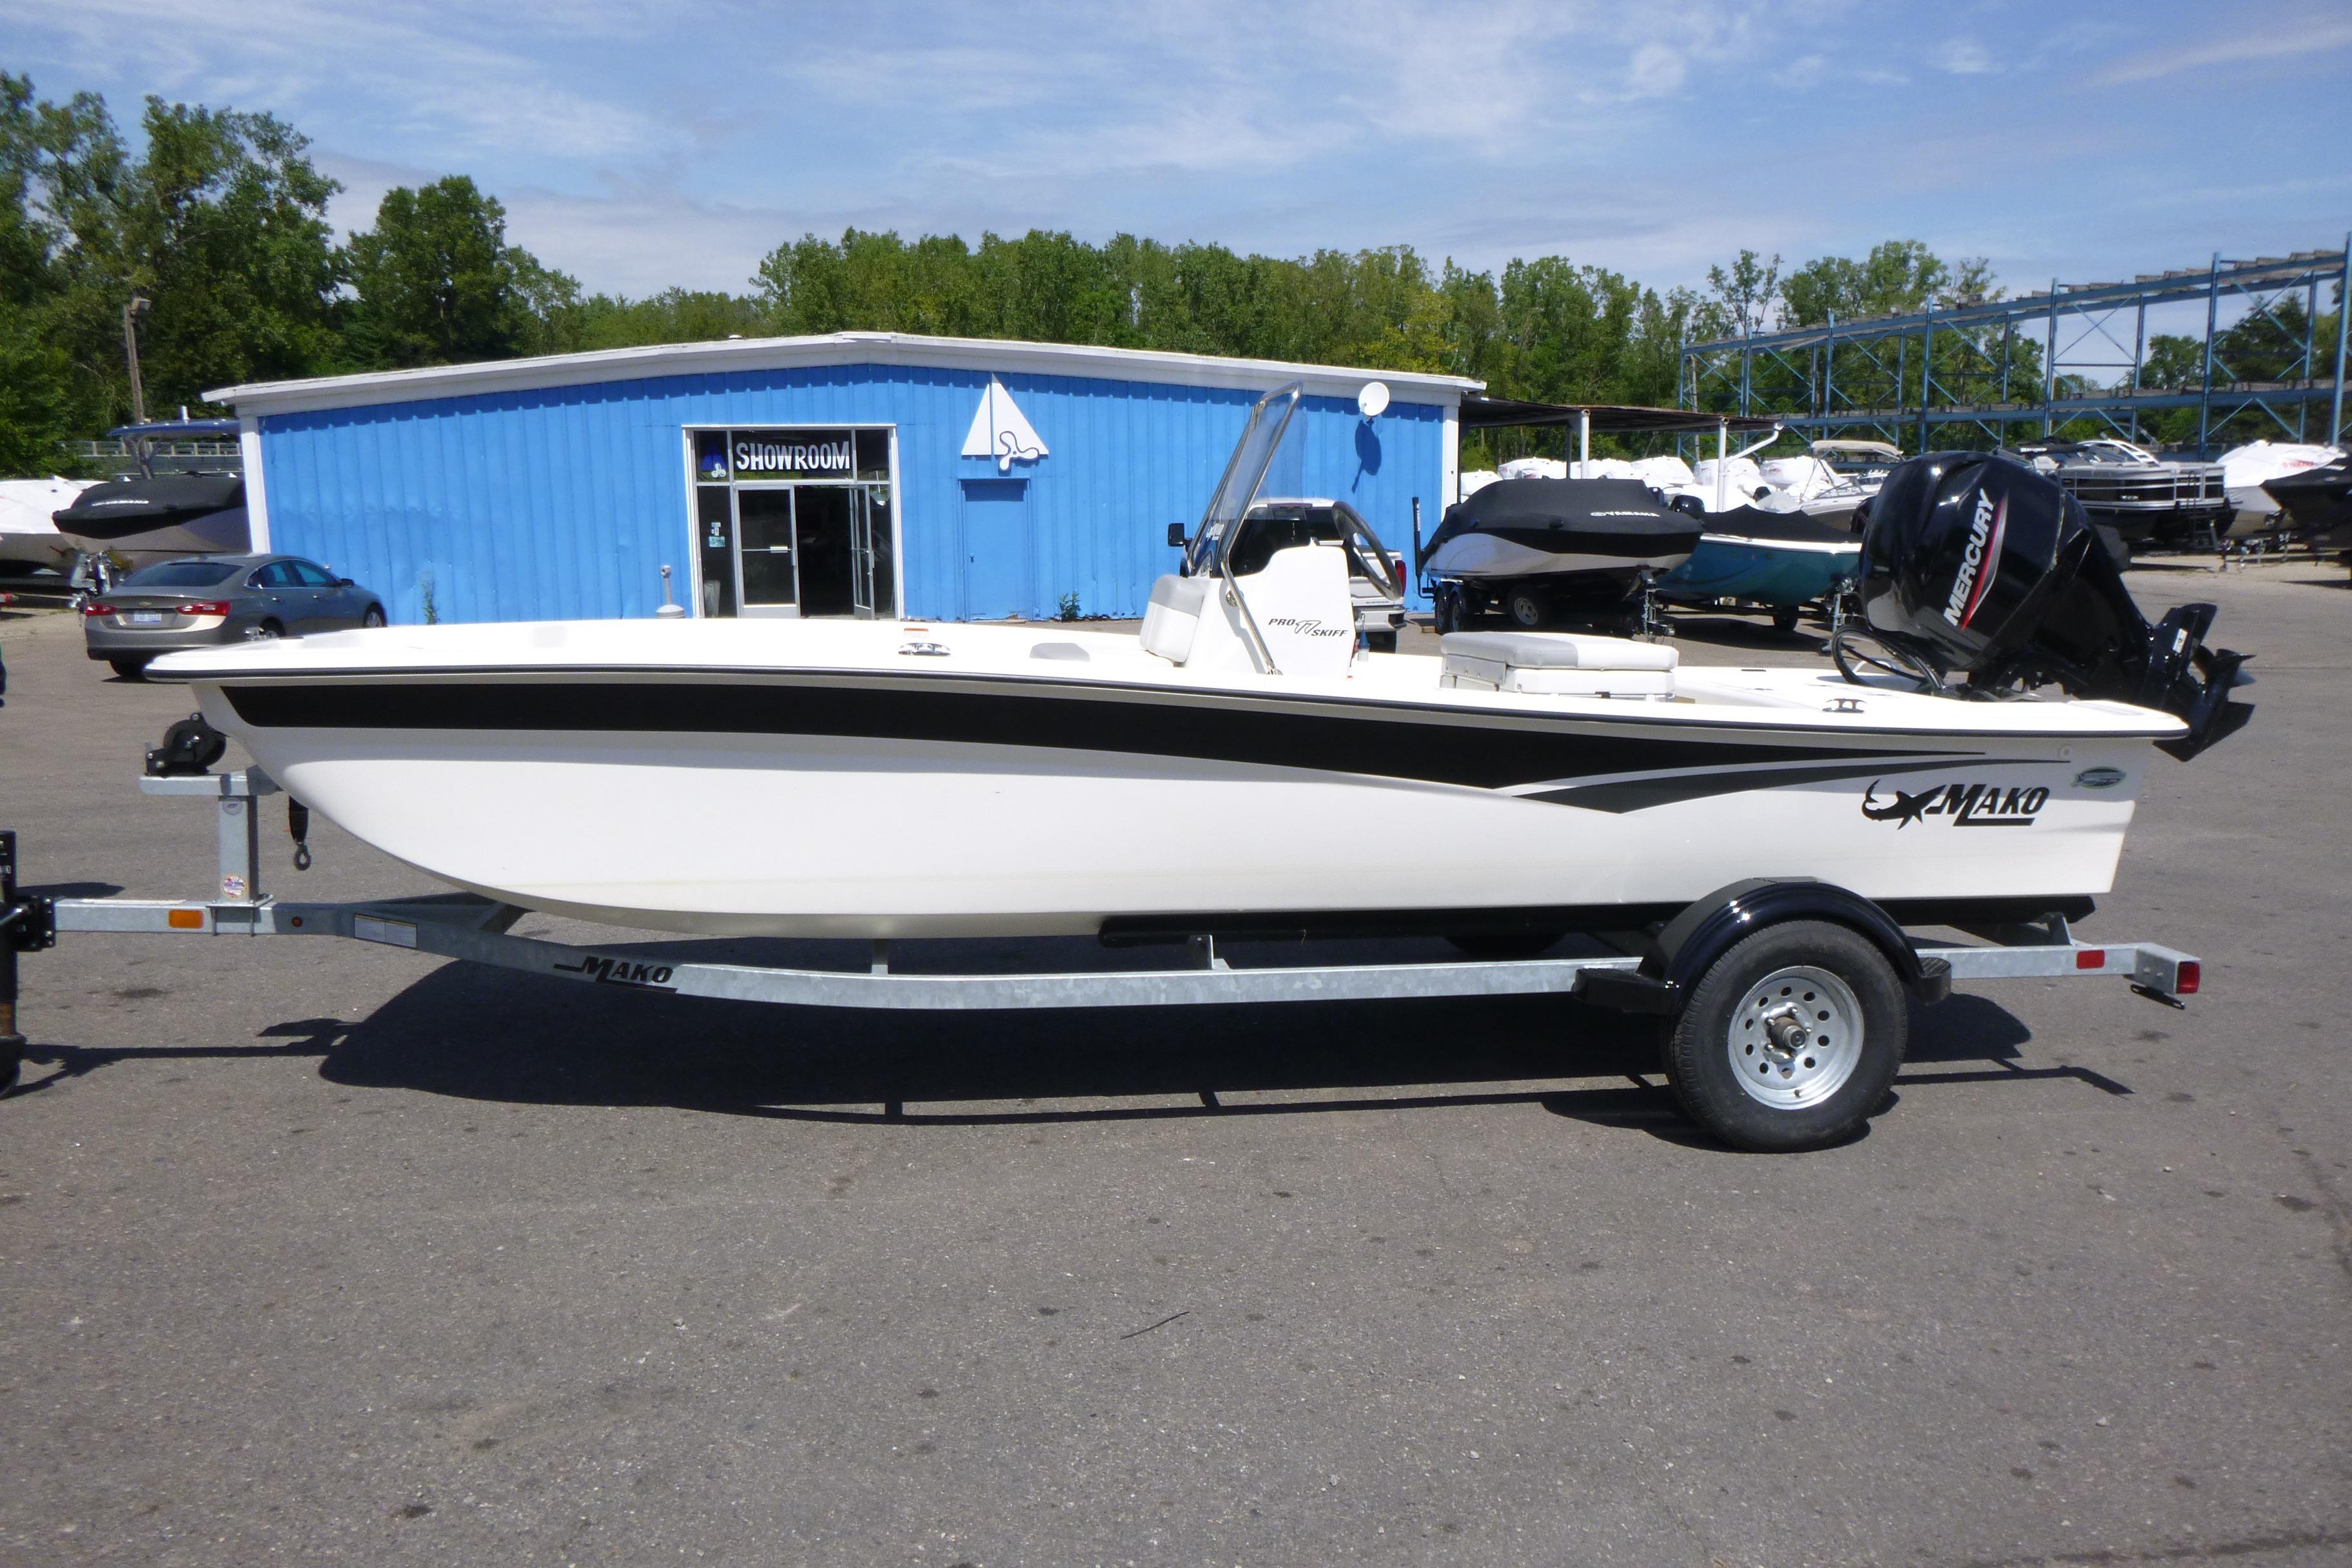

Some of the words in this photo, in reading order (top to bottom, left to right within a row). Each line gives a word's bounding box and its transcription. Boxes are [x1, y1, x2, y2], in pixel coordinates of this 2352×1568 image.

[736, 441, 850, 471] SHOWROOM
[1943, 488, 1995, 627] MERCURY
[1294, 620, 1322, 634] 17
[1925, 783, 2050, 827] MAKO
[553, 956, 678, 994] MAKO
